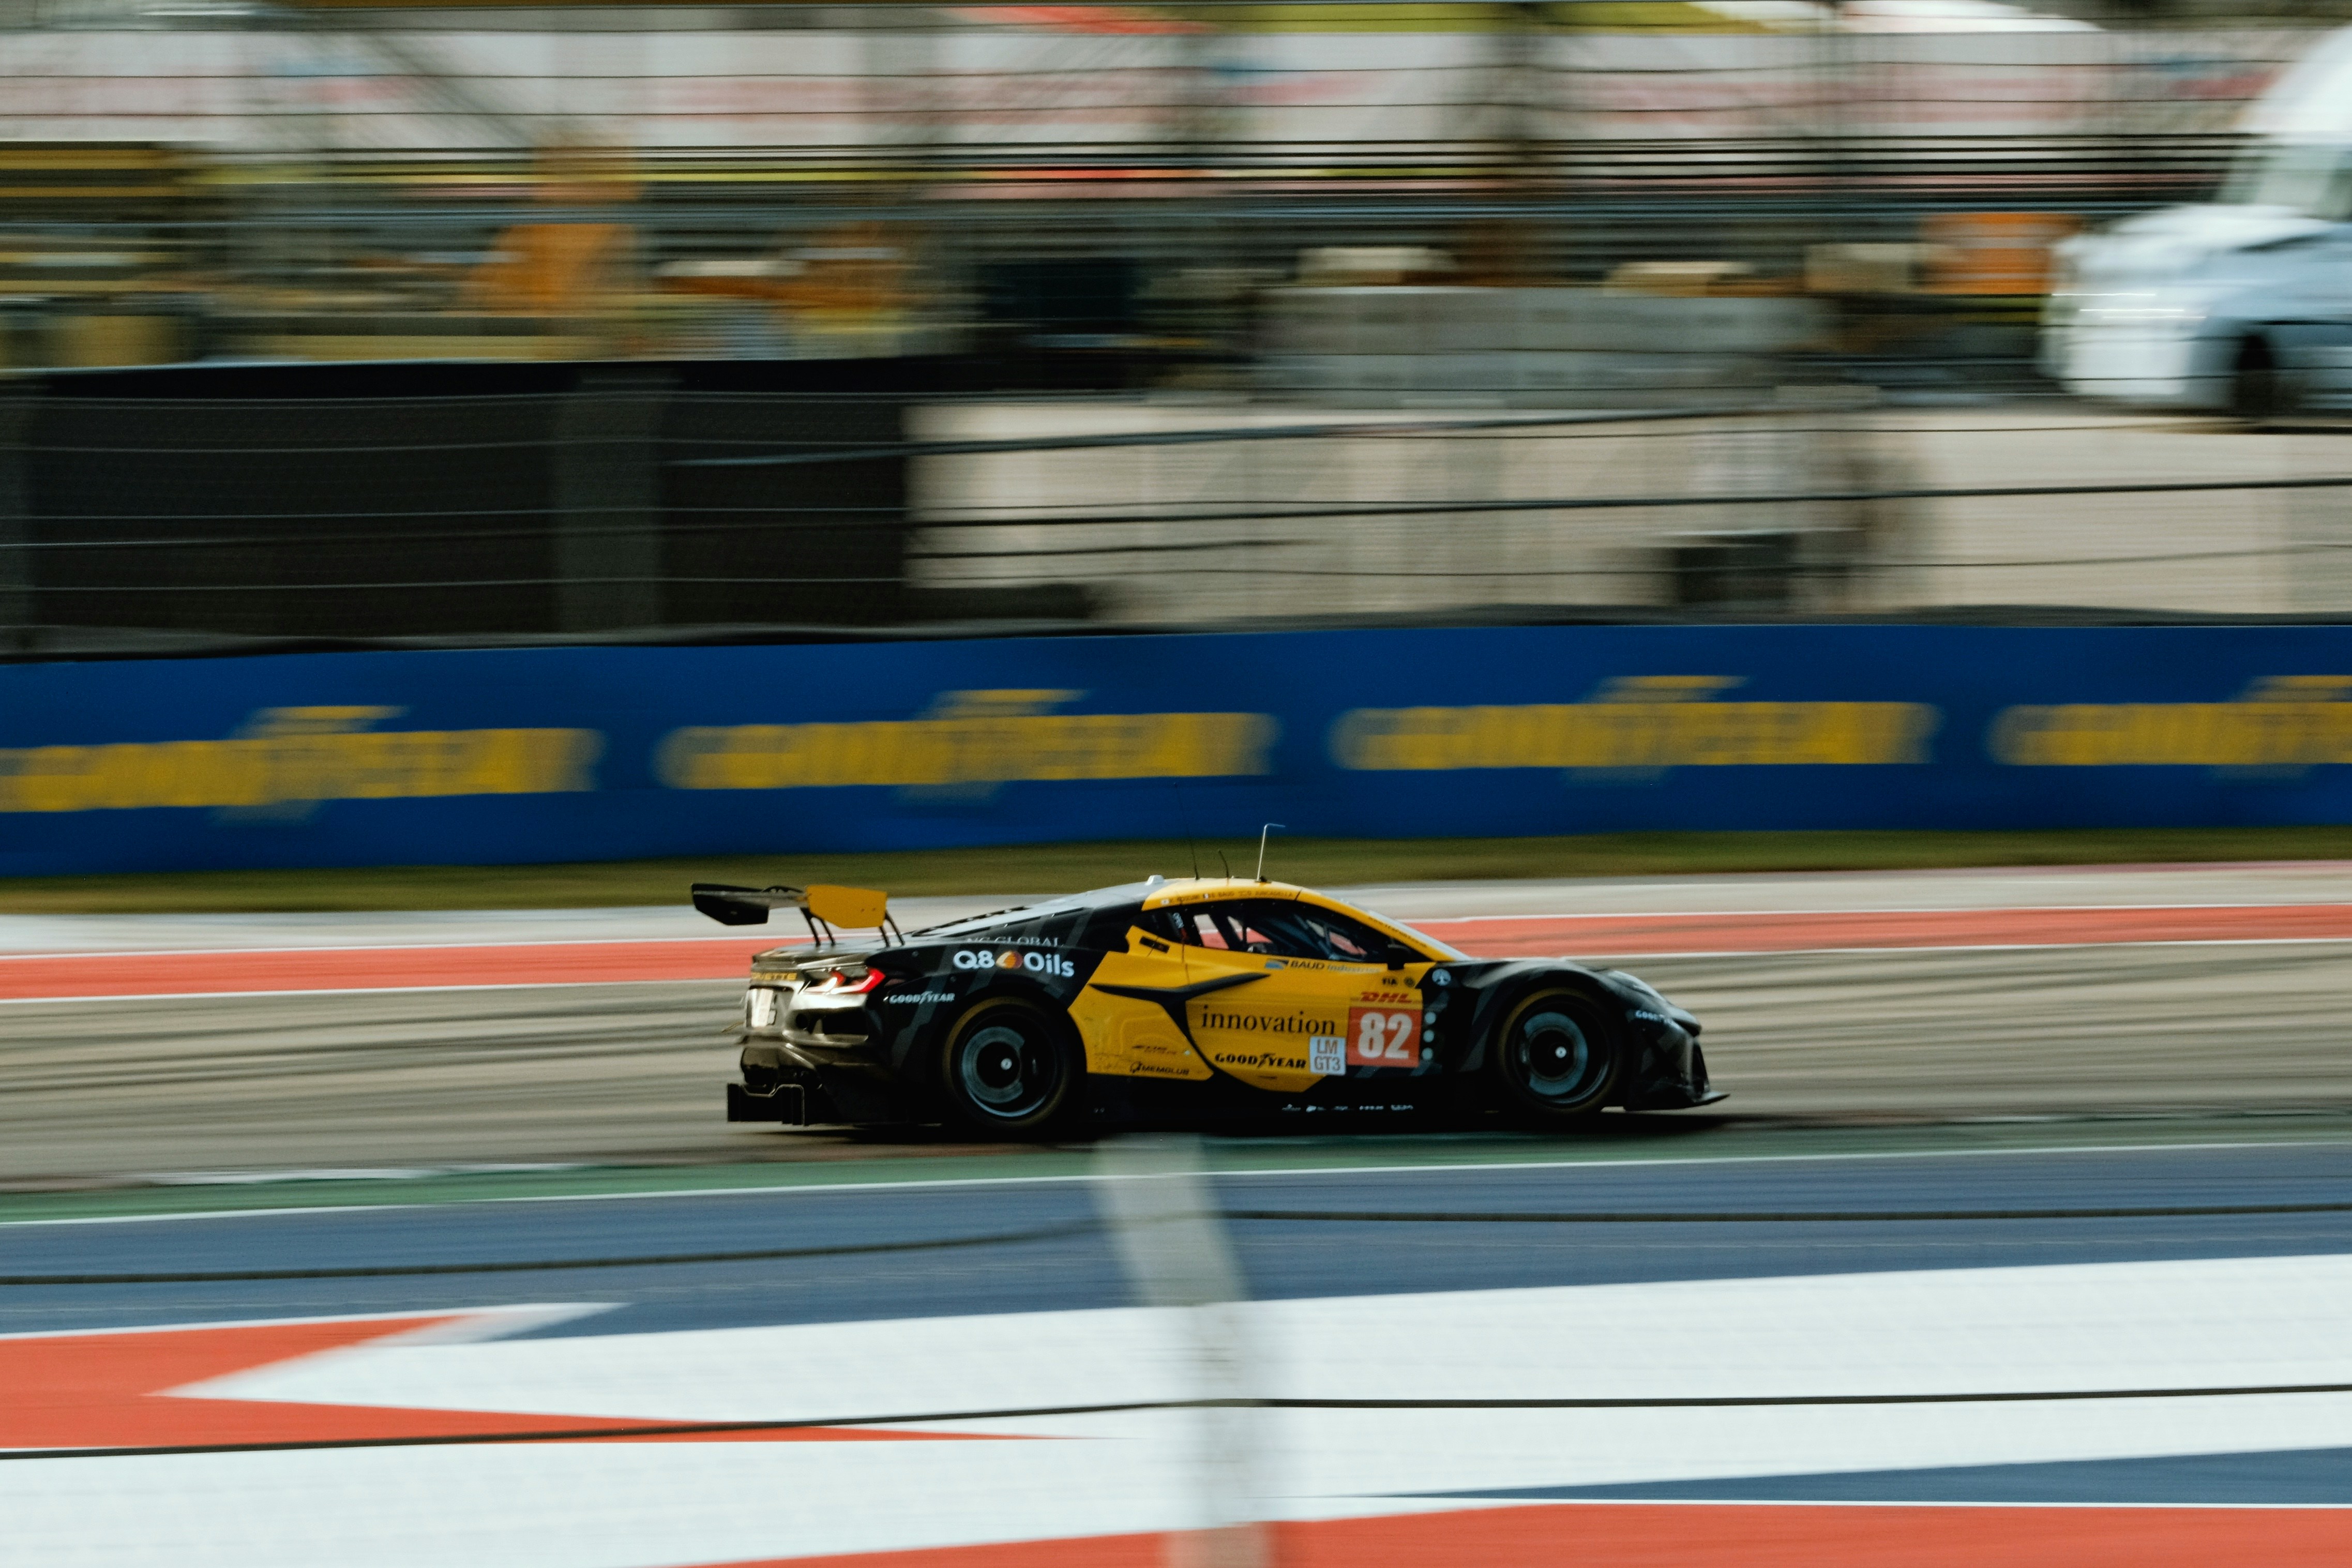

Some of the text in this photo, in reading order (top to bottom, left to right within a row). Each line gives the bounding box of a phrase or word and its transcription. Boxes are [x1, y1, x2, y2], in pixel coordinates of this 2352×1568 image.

[953, 950, 1075, 977] Q8 Oils
[1290, 960, 1325, 970] BAUD
[1382, 977, 1397, 986] FIA
[889, 990, 955, 1005] GOODYEAR
[1360, 991, 1412, 1003] DHL
[1201, 1004, 1336, 1035] innovation
[1358, 1012, 1412, 1060] 82
[1317, 1038, 1338, 1054] LM
[1214, 1052, 1306, 1068] GOODYEAR
[1314, 1055, 1340, 1072] GT3
